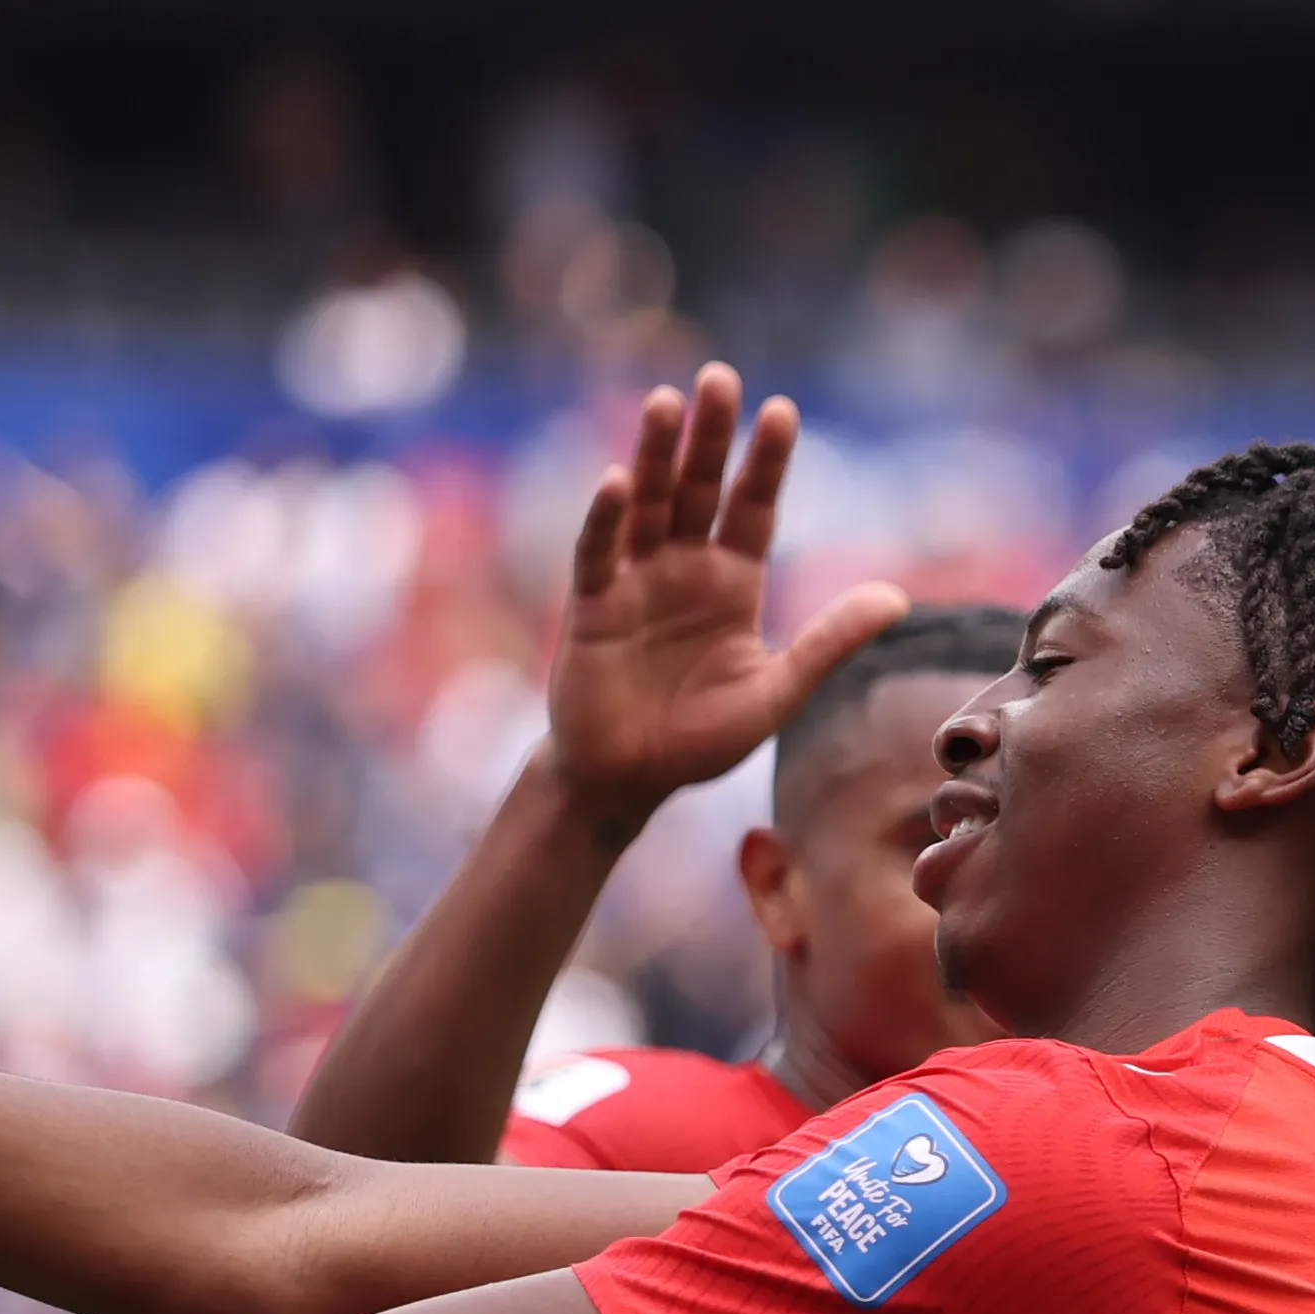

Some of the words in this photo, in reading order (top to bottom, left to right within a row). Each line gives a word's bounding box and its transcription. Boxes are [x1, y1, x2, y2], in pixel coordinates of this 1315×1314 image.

[818, 1179, 887, 1254] PEACE
[842, 1156, 890, 1203] Unite
[875, 1194, 913, 1228] For
[810, 1213, 844, 1256] FIFA
